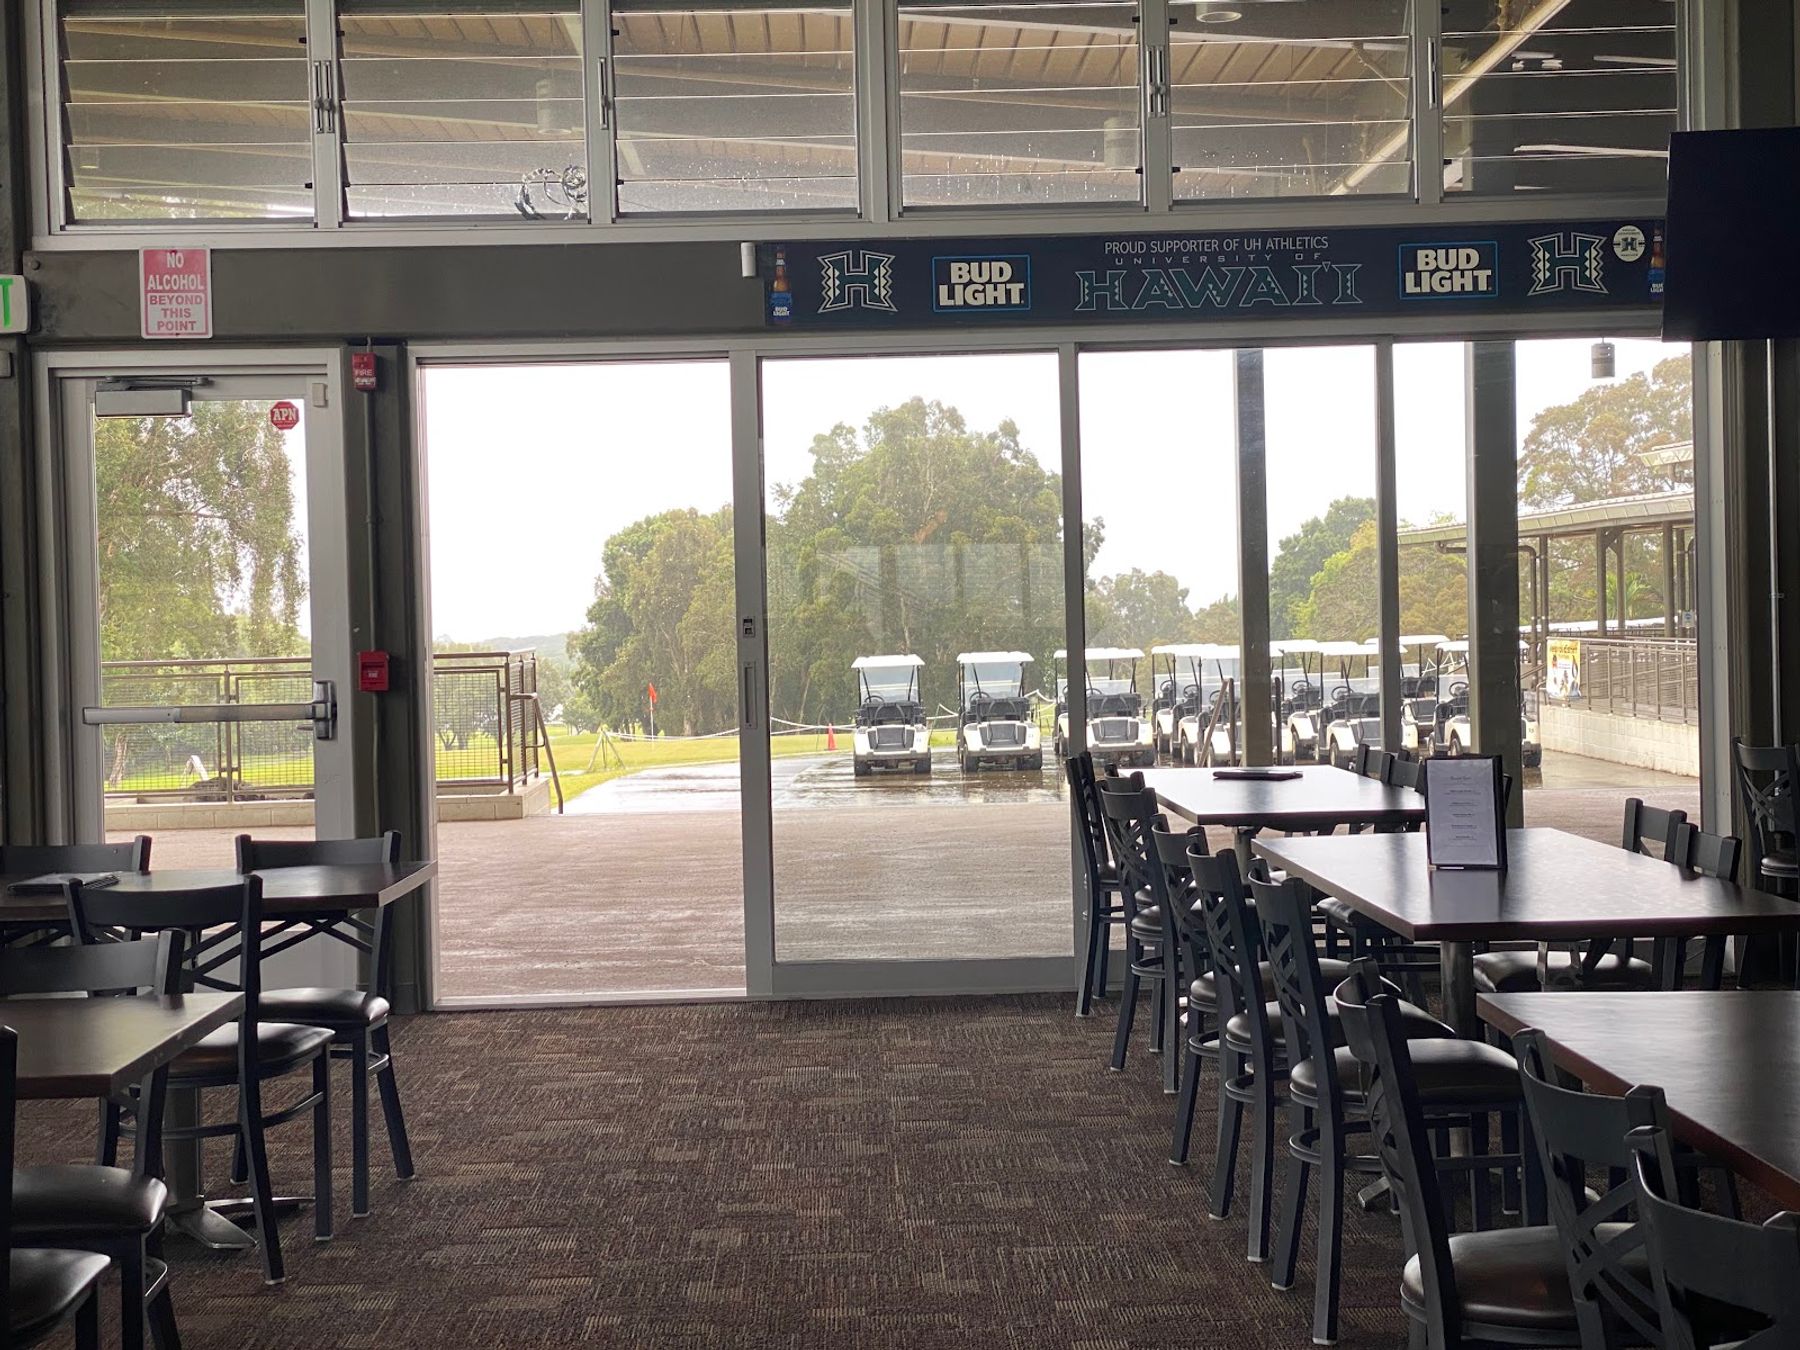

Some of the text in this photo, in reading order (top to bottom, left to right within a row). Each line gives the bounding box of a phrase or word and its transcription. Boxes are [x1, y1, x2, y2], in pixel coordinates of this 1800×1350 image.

[1104, 236, 1329, 254] PROUD SUPPORTER OF UH ATHLETICS
[166, 252, 185, 268] NO
[1115, 252, 1321, 265] UNIVERSITY OF
[1416, 248, 1480, 271] BUD
[950, 261, 1013, 284] BUD
[147, 274, 204, 290] ALCOHOL
[1405, 269, 1492, 293] LIGHT
[149, 294, 203, 305] BEYOND
[938, 282, 1024, 306] LIGHT
[161, 308, 192, 318] THIS
[157, 321, 197, 331] POINT
[273, 407, 297, 421] APN
